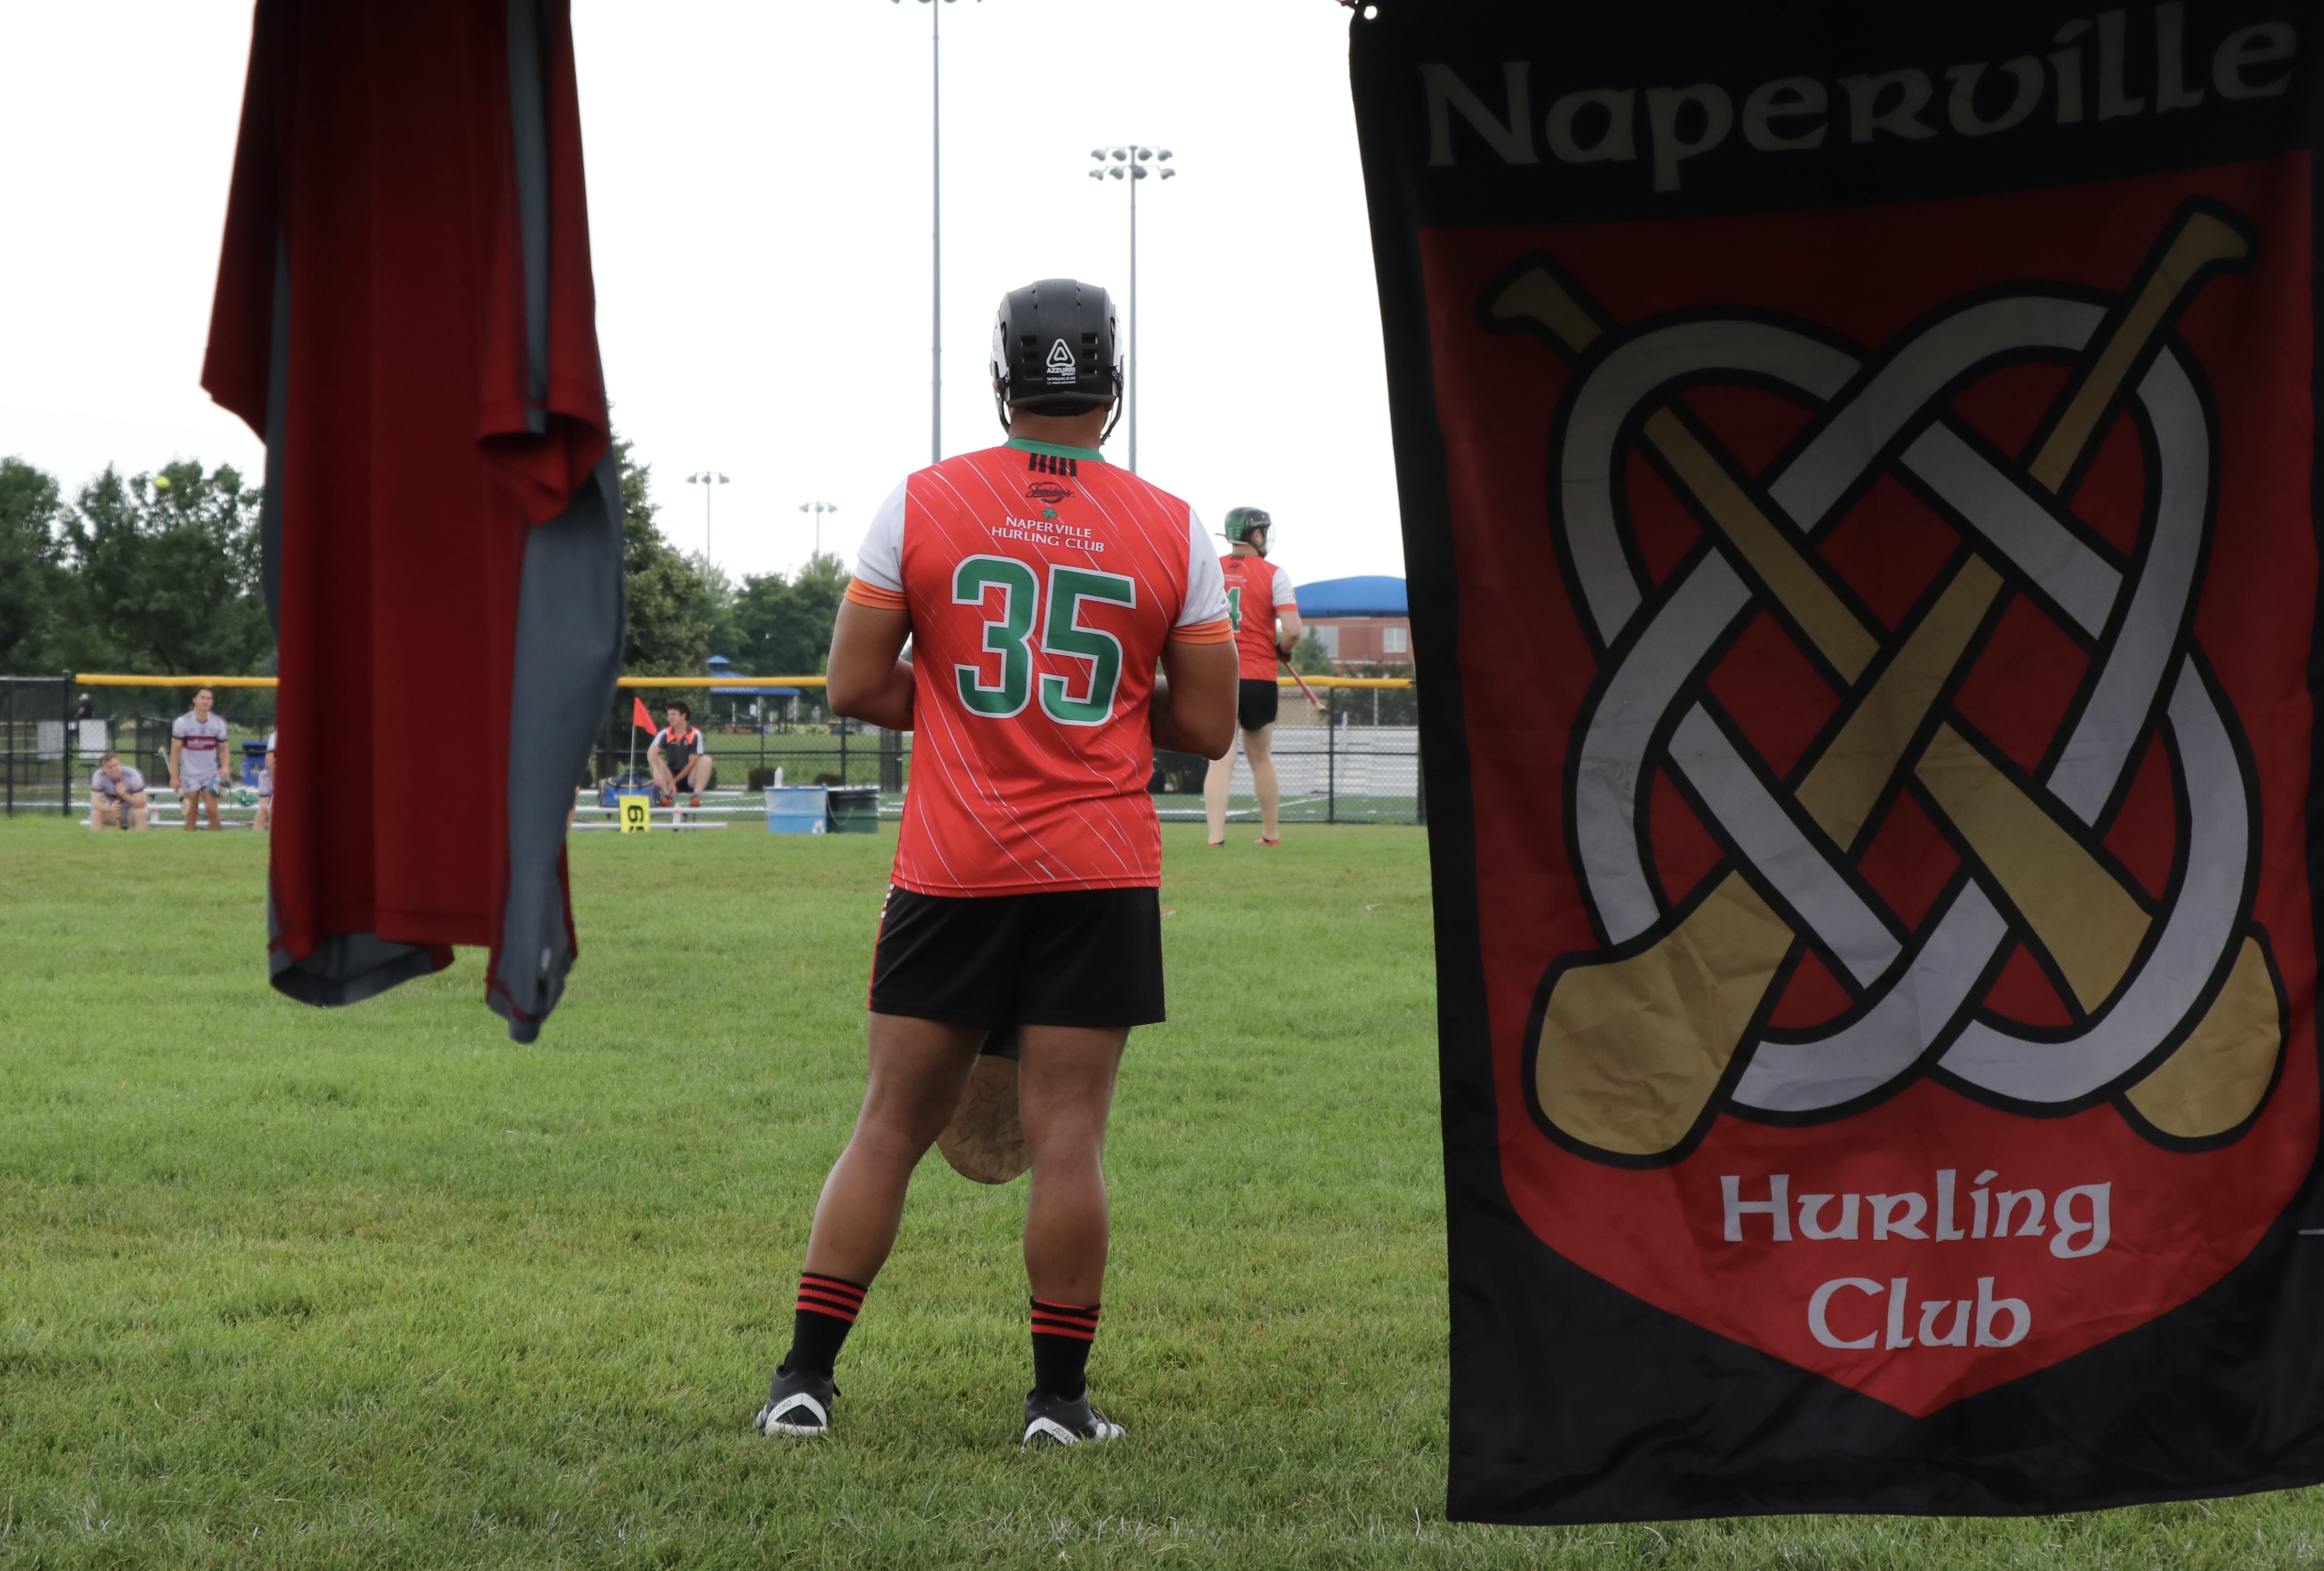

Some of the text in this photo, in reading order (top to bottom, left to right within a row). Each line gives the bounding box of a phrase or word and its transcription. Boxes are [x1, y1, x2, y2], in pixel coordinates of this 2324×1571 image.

[992, 526, 1105, 552] HURLING CLUB
[1006, 516, 1092, 538] NAPERVILLE
[952, 553, 1137, 727] 35
[1720, 1168, 2112, 1259] Hurling
[1808, 1276, 2032, 1351] Club
